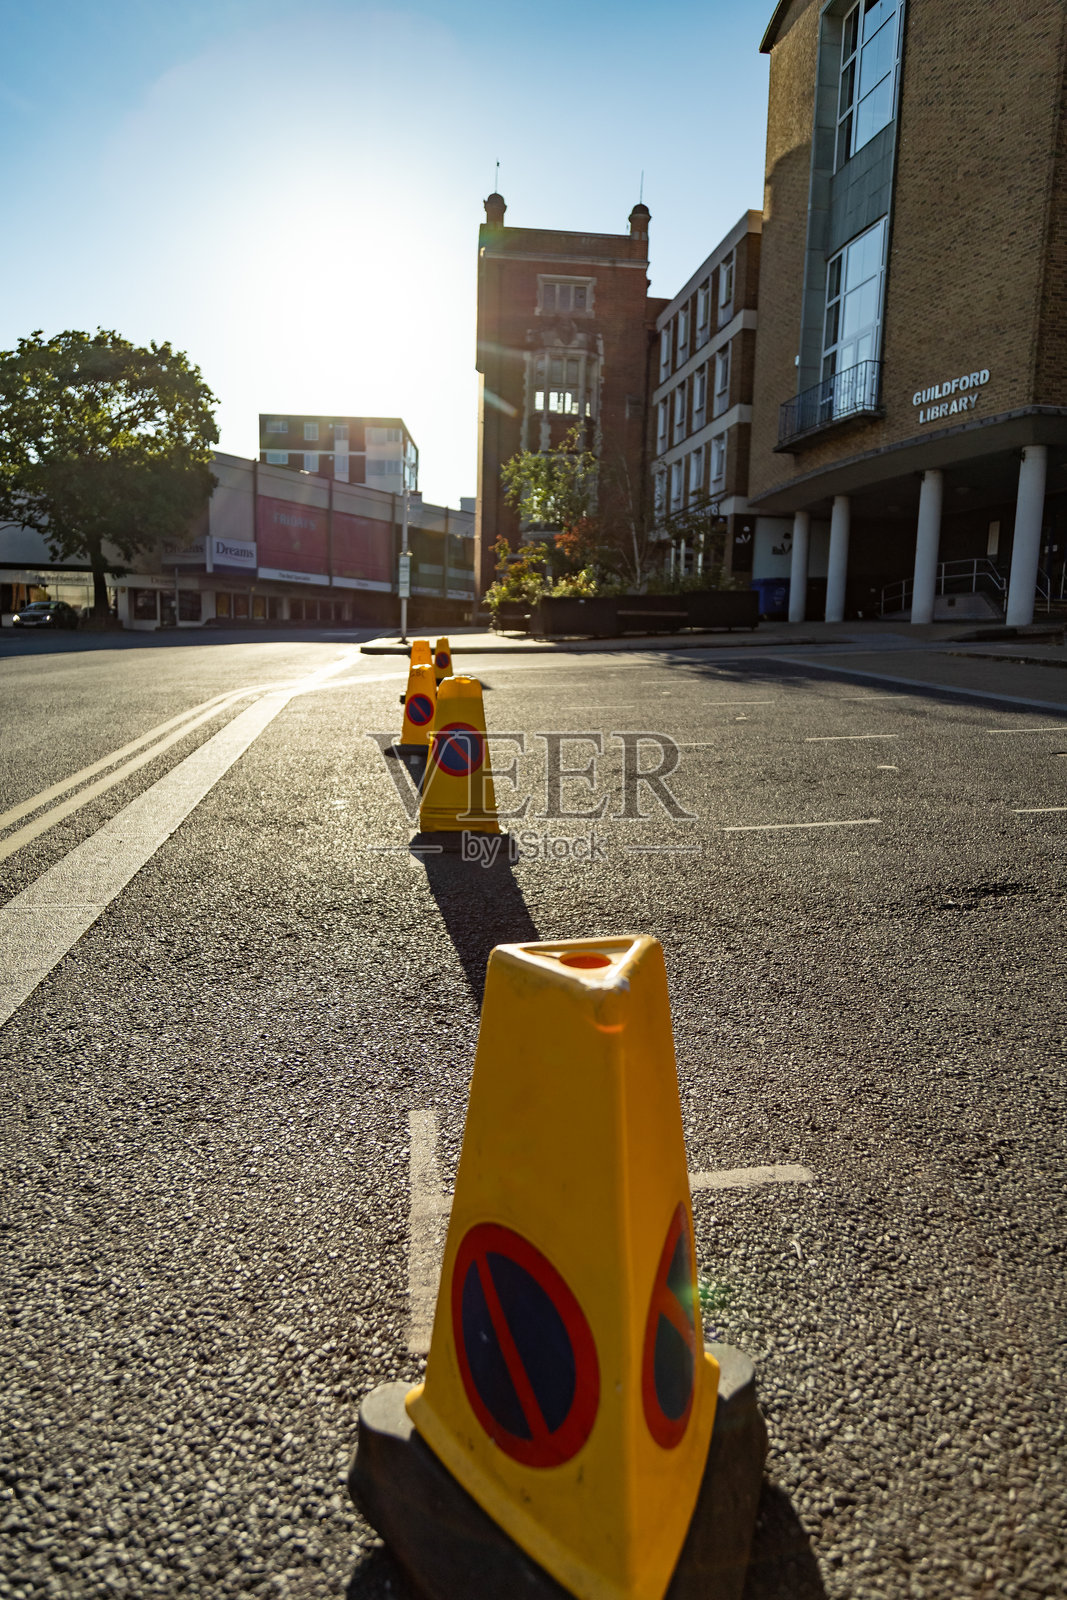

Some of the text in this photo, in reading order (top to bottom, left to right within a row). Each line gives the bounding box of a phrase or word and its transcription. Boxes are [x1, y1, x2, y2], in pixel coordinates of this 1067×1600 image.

[912, 368, 990, 407] GUILDFORD
[919, 393, 978, 425] LIBRARY
[215, 541, 254, 559] Dreams
